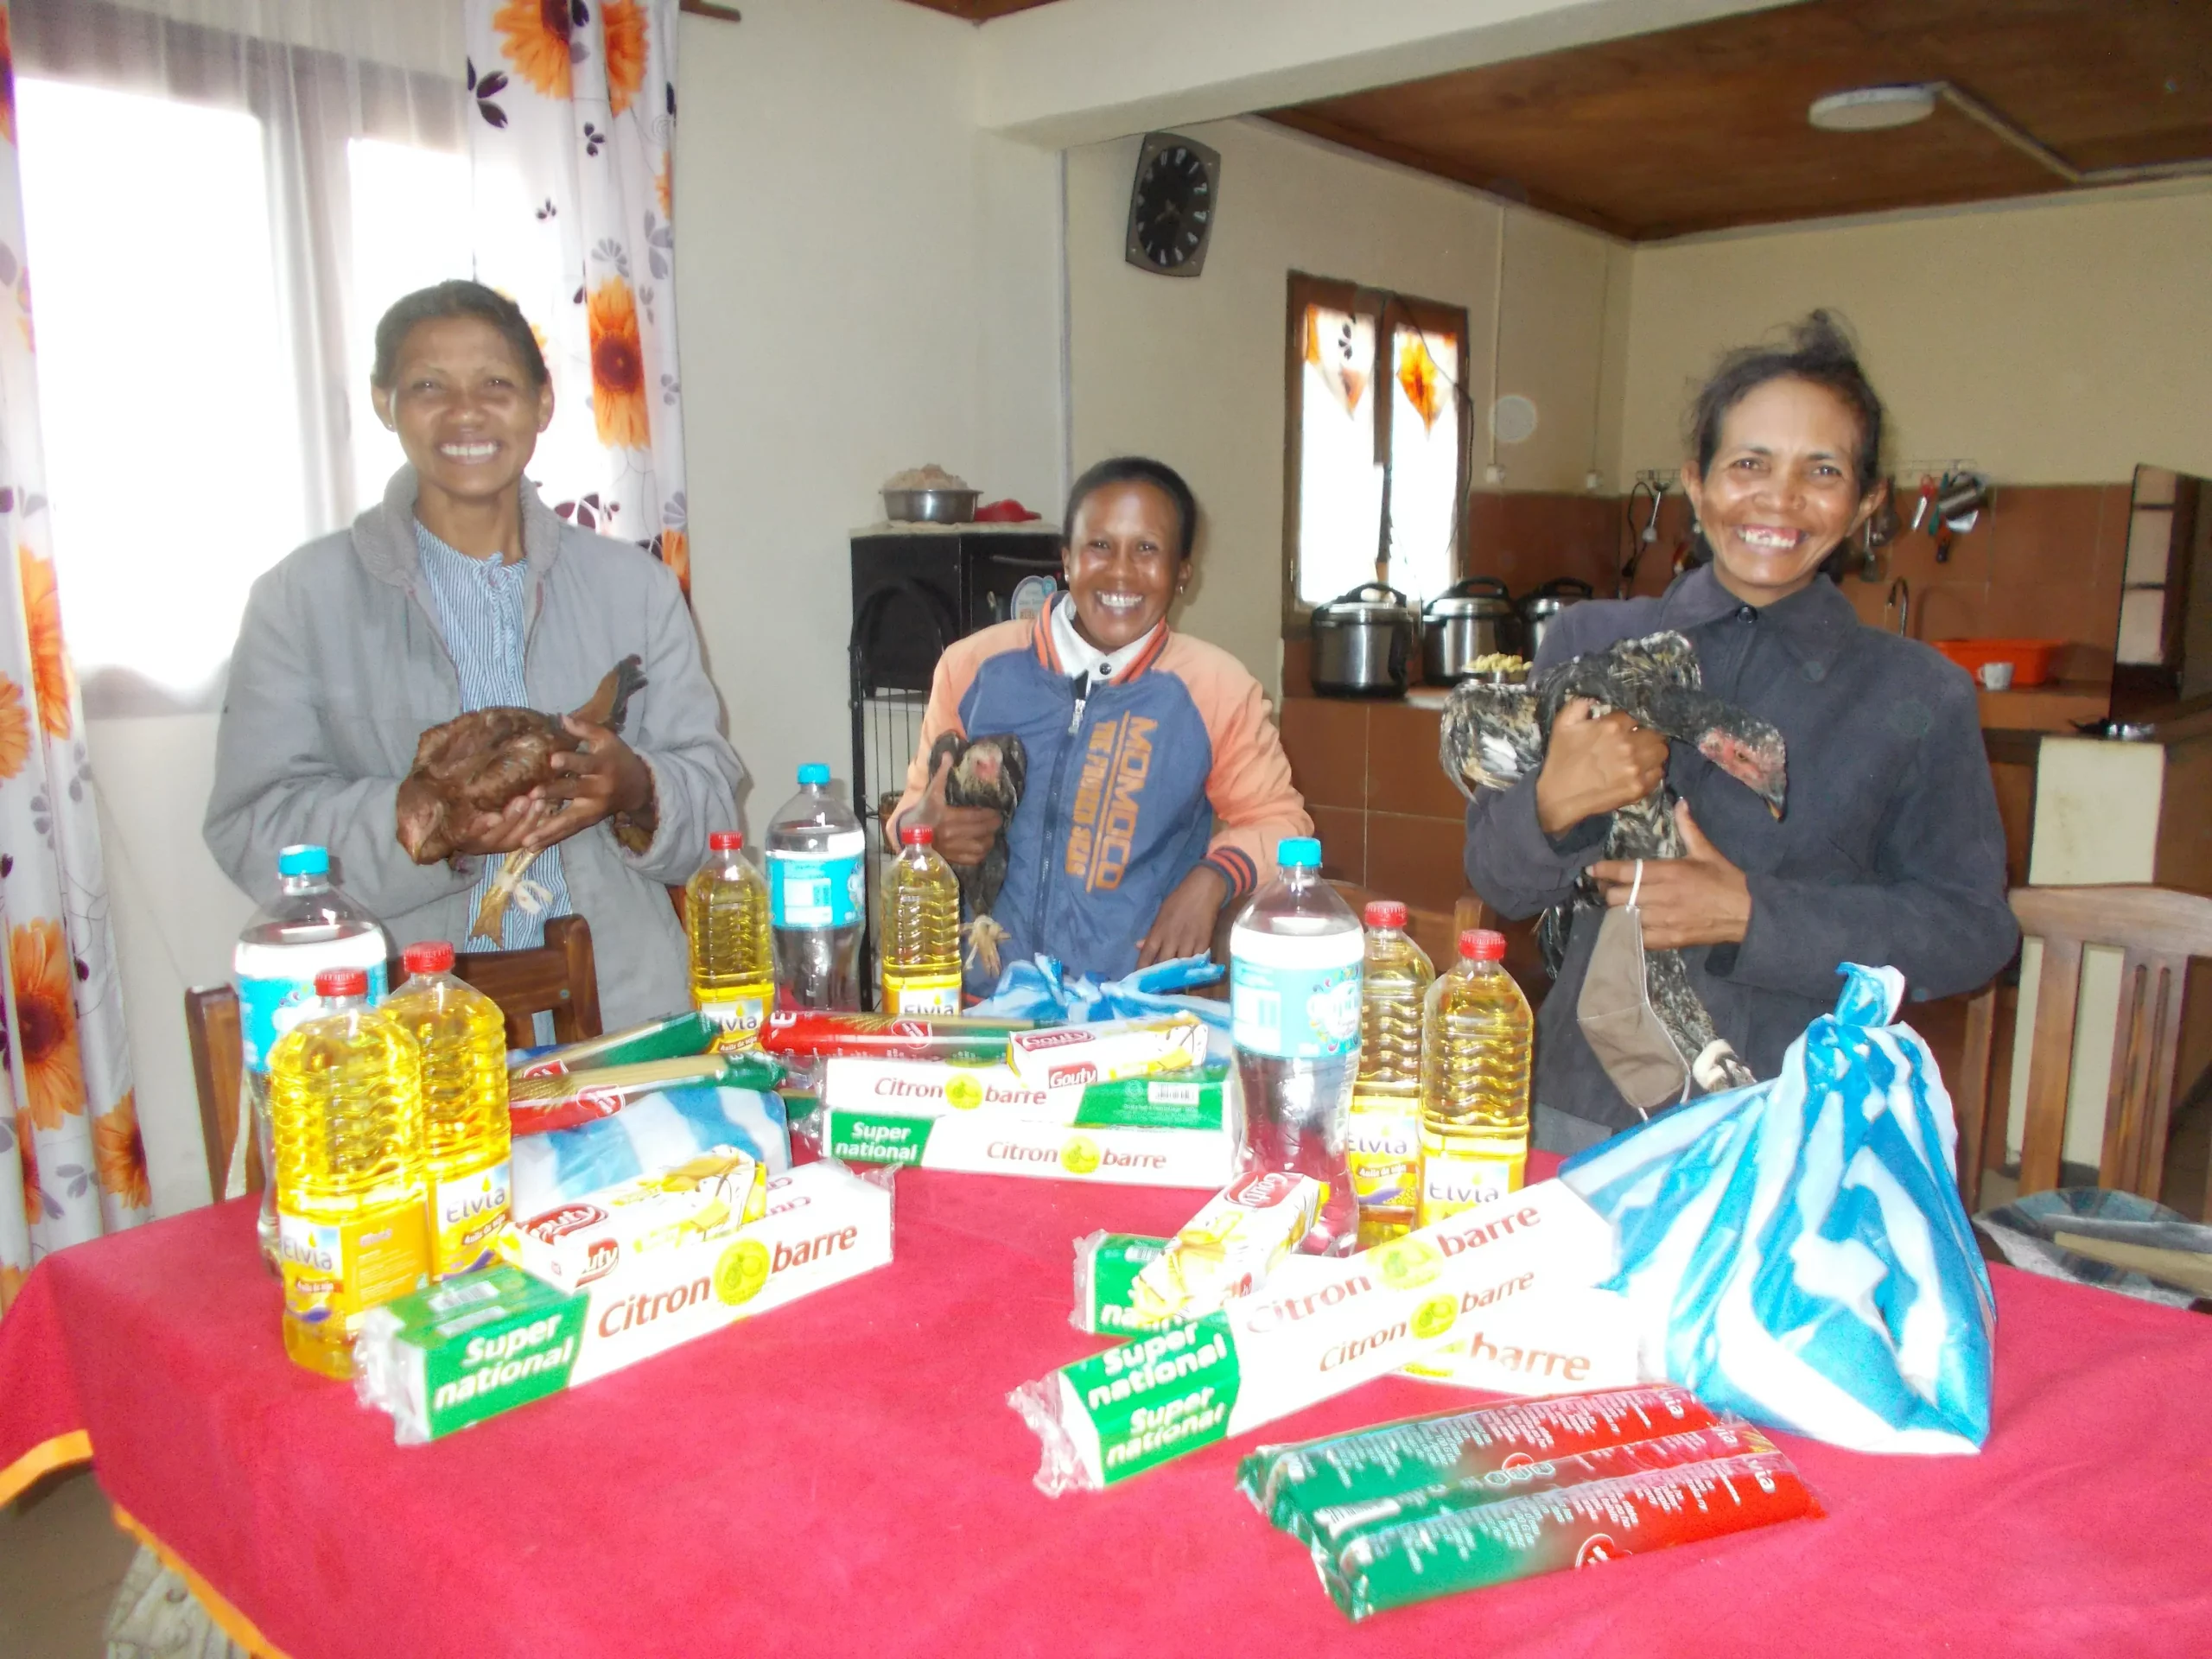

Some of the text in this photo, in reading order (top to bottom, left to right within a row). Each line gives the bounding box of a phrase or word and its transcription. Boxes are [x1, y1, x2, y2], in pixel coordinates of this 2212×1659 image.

[1096, 716, 1159, 891] MOMOCO
[718, 1014, 758, 1032] lvia
[1022, 1030, 1090, 1047] Gouty
[874, 1077, 1046, 1105] Citron barre
[1050, 1067, 1096, 1087] Gouty
[836, 1141, 918, 1161] national
[851, 1121, 910, 1142] Super
[987, 1141, 1166, 1169] Citron barre
[446, 1185, 506, 1224] Elvia
[282, 1234, 333, 1270] Elvia
[1245, 1270, 1372, 1334] Citron
[1436, 1205, 1541, 1260] barre
[598, 1224, 859, 1339] Citron barre
[465, 1315, 562, 1368] Super
[1319, 1322, 1407, 1374] Citron
[1459, 1268, 1535, 1315] barre
[434, 1336, 574, 1409] national
[1087, 1339, 1229, 1406] national
[1103, 1323, 1200, 1376] Super
[1469, 1332, 1591, 1382] barre
[1130, 1387, 1215, 1434] Super
[1106, 1403, 1226, 1467] national
